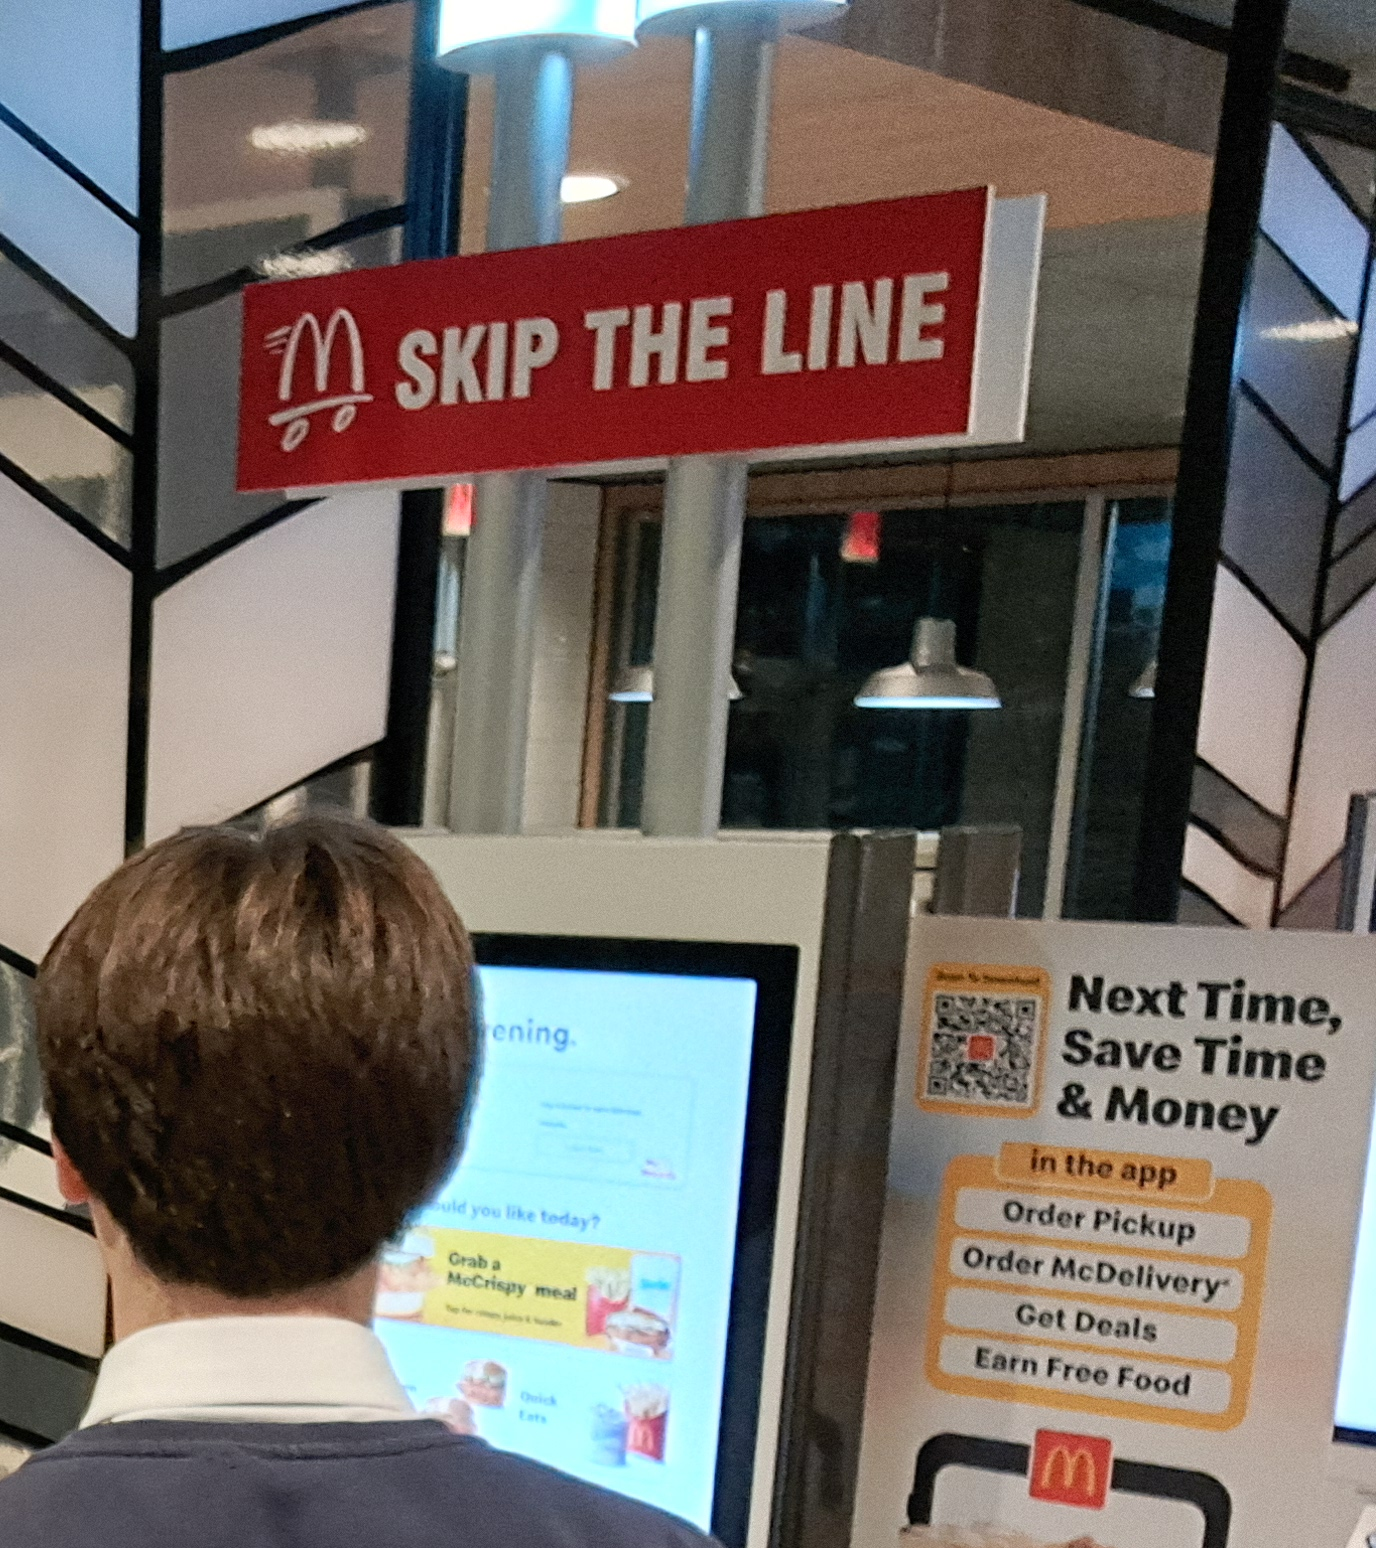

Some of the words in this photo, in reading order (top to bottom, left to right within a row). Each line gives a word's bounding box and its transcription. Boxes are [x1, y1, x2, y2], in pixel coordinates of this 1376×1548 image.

[393, 315, 561, 413] SKIP
[584, 295, 734, 392] THE
[761, 270, 951, 376] LINE
[1067, 975, 1187, 1020] Next
[1197, 979, 1344, 1036] Time,
[487, 1018, 577, 1052] ening.
[1061, 1029, 1182, 1073] Save
[1194, 1035, 1328, 1082] Time
[1056, 1082, 1092, 1121] &
[1104, 1086, 1279, 1146] Money
[1030, 1148, 1058, 1174] in
[1065, 1152, 1114, 1180] the
[1121, 1161, 1179, 1191] app
[470, 1204, 501, 1220] you
[505, 1203, 537, 1222] like
[541, 1210, 601, 1232] today?
[1002, 1200, 1086, 1231] Order
[1093, 1208, 1197, 1247] Pickup
[448, 1251, 488, 1270] Grab
[492, 1258, 502, 1271] a
[962, 1247, 1045, 1276] Order
[447, 1271, 527, 1298] McCrispy
[535, 1286, 578, 1301] meal
[1015, 1303, 1065, 1332] Get
[1074, 1311, 1159, 1344] Deals
[974, 1345, 1039, 1376] Earn
[1045, 1355, 1110, 1387] Free
[1117, 1364, 1193, 1397] Food
[518, 1410, 548, 1425] Eats
[519, 1389, 558, 1407] Quick
